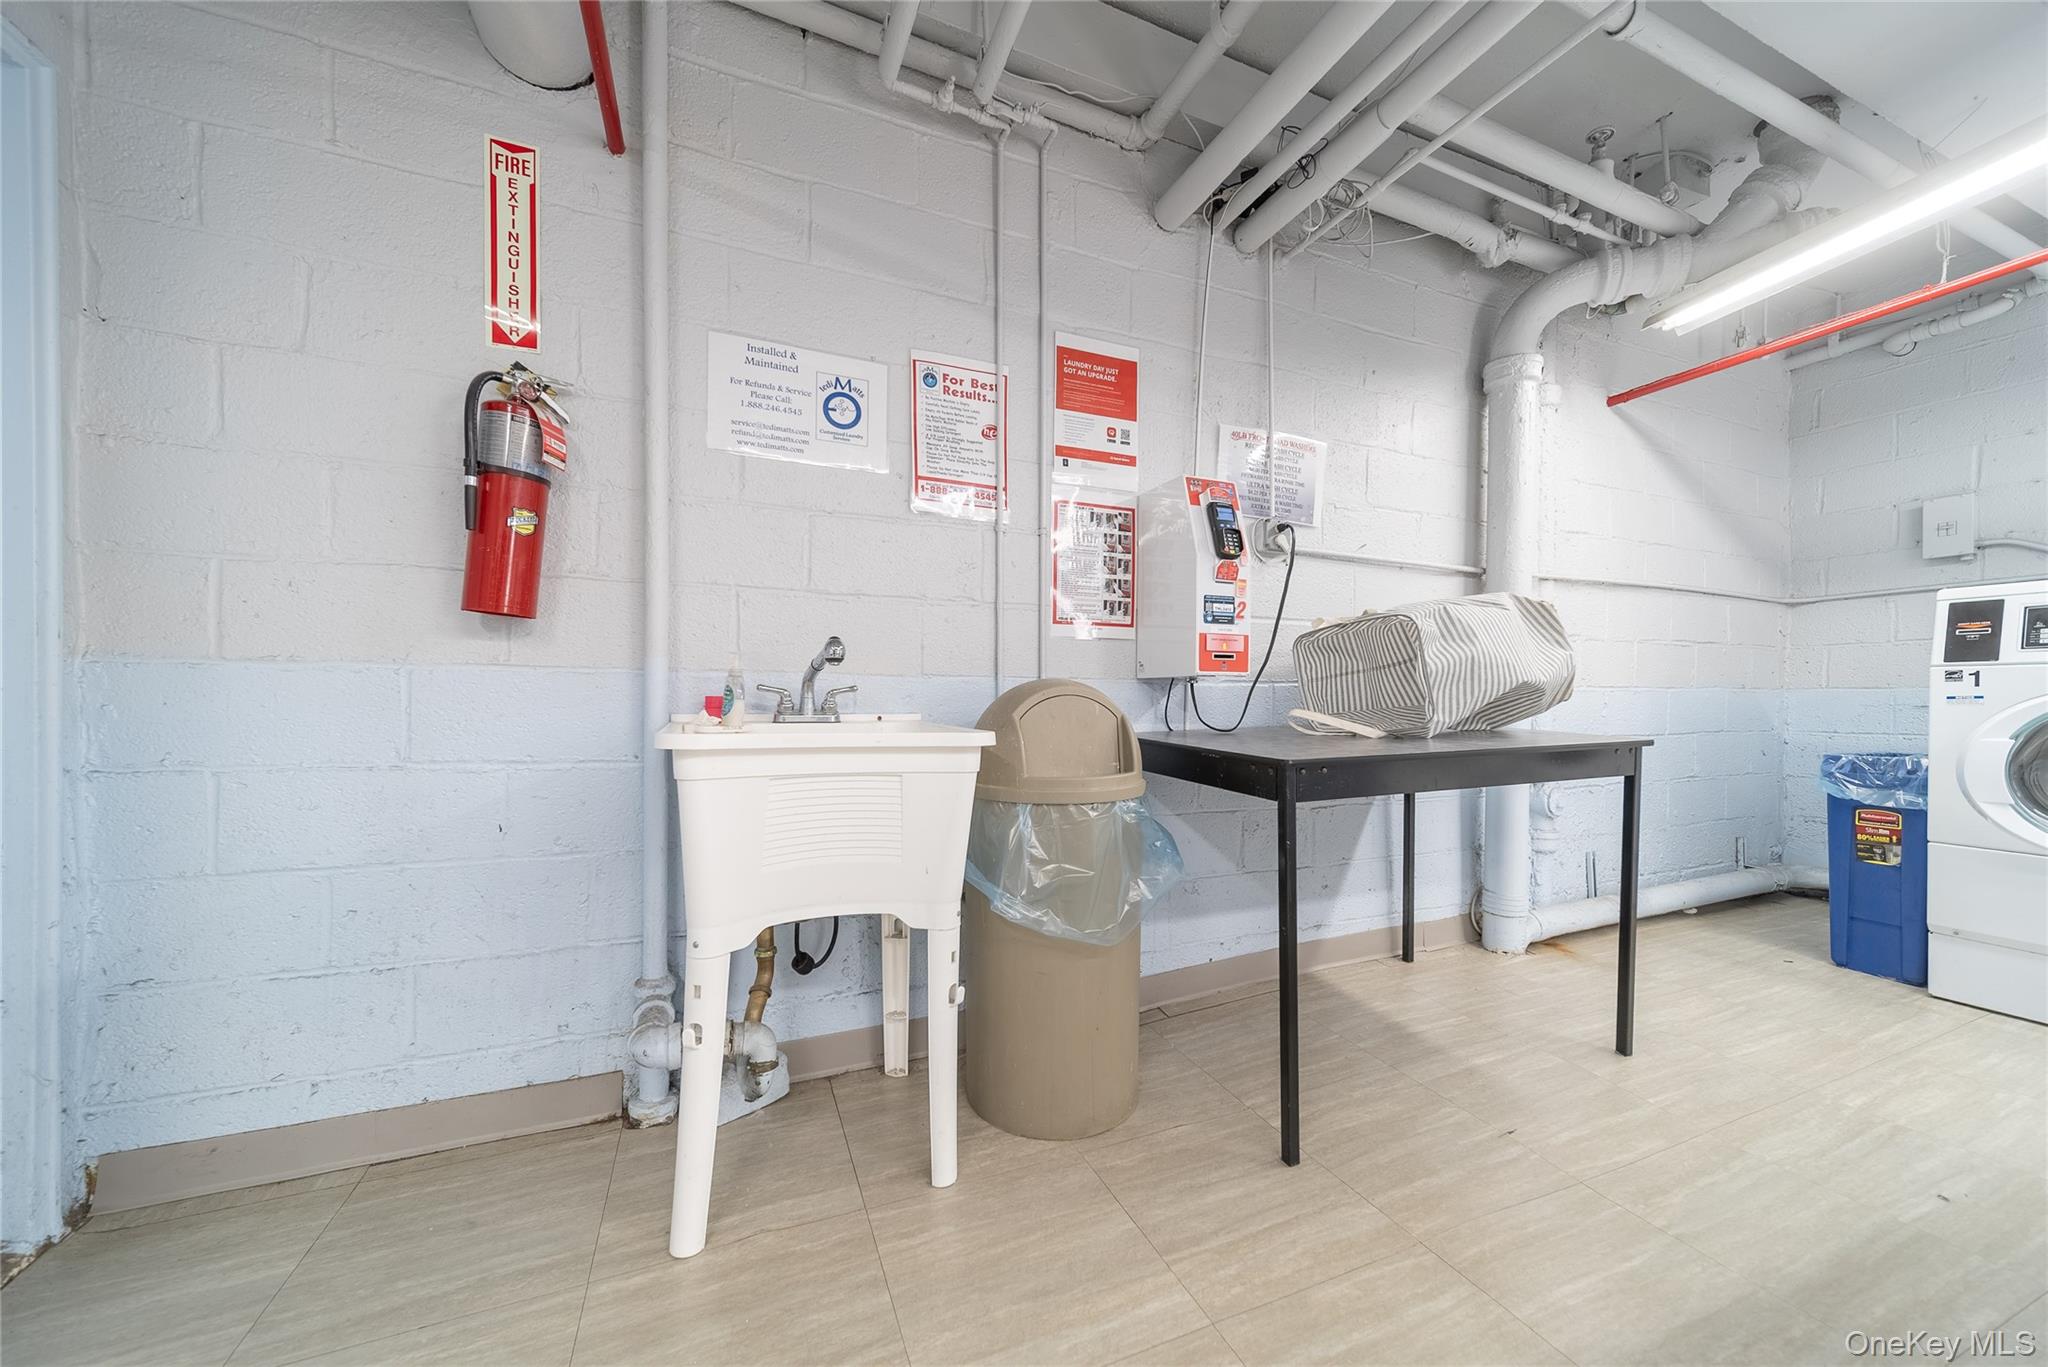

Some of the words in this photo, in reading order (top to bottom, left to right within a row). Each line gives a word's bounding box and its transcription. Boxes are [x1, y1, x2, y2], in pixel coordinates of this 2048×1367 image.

[494, 152, 531, 178] FIRE
[747, 343, 787, 359] Installed
[789, 349, 797, 360] &
[744, 356, 799, 374] Maintained
[1063, 358, 1092, 370] LAUNDRY
[1093, 365, 1105, 373] DAY
[1105, 367, 1119, 376] JUST
[1063, 367, 1077, 375] GOT
[1077, 369, 1087, 377] AN
[729, 377, 742, 386] For
[744, 378, 776, 390] Refunds
[785, 385, 813, 398] Service
[942, 373, 965, 388] For
[750, 390, 774, 401] Please
[775, 394, 793, 404] Call:
[1236, 601, 1247, 619] 2
[1968, 670, 1980, 687] 1
